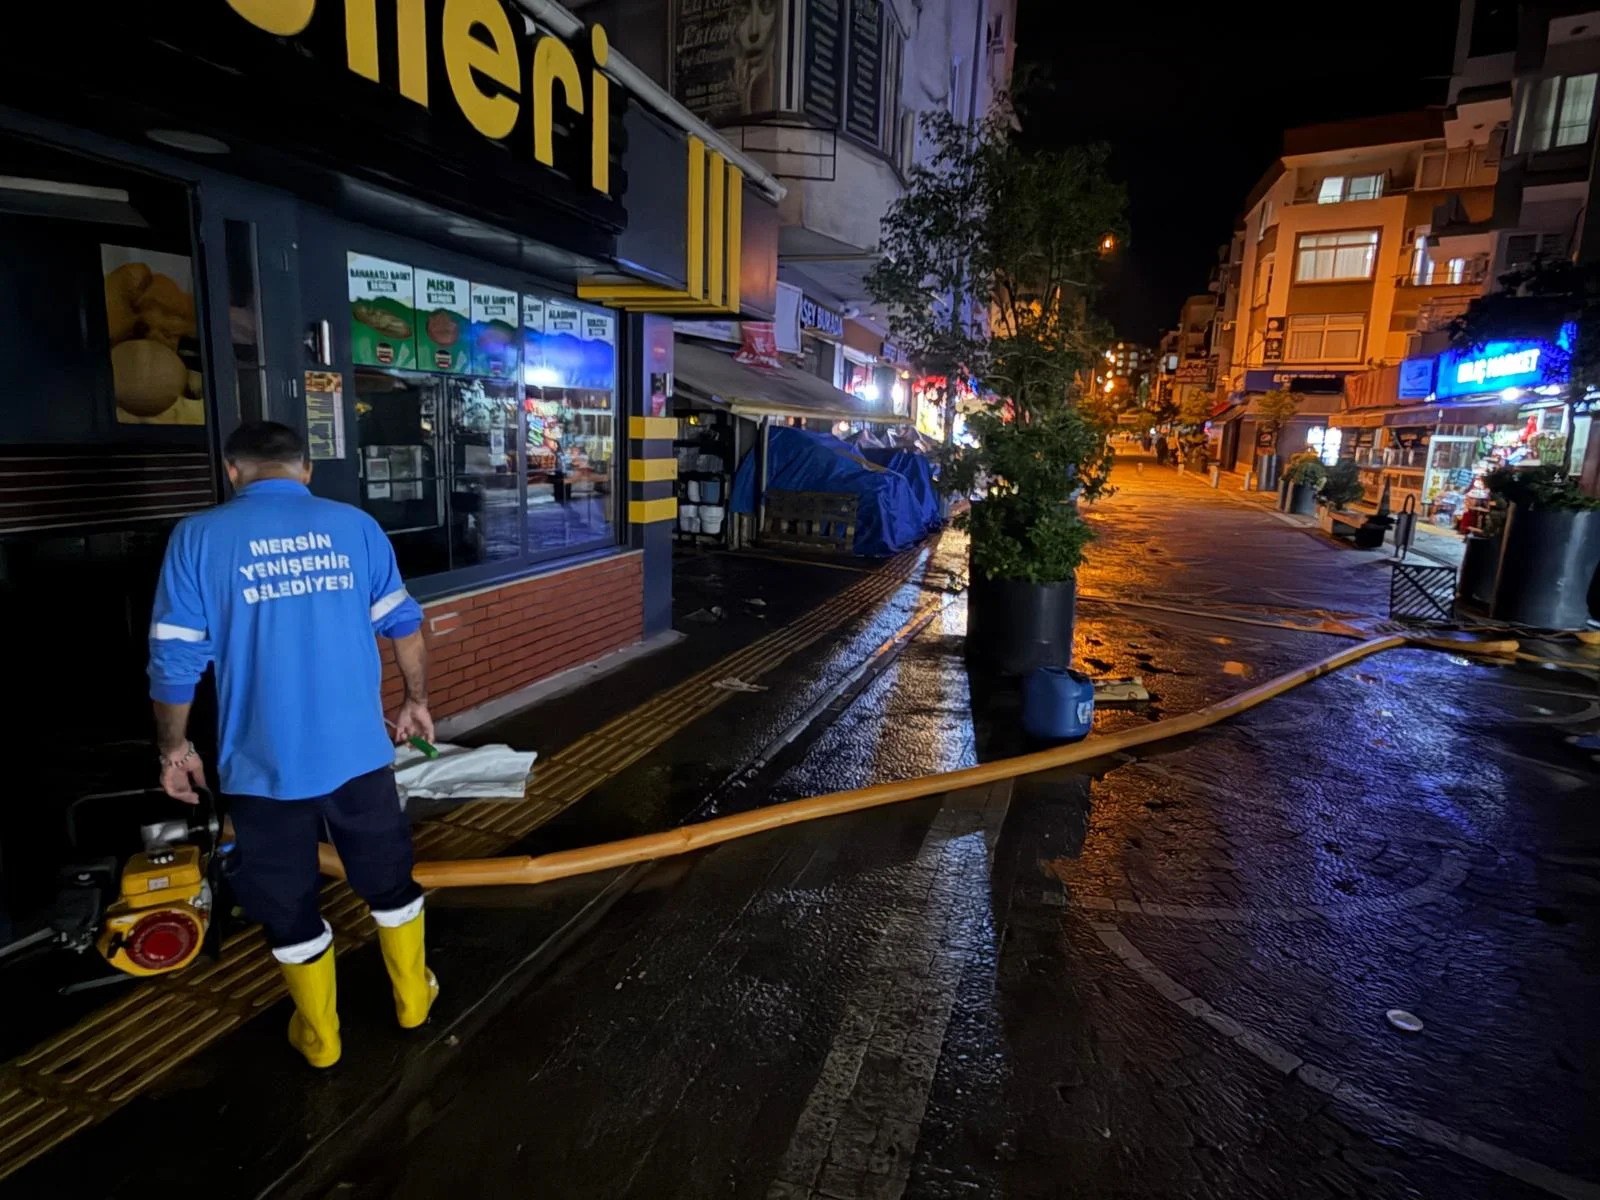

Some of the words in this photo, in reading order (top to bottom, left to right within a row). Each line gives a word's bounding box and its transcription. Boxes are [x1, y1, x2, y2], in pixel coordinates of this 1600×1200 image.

[426, 278, 456, 293] MISIR
[249, 531, 332, 557] MERSİN
[239, 551, 351, 581] YENİŞEHİR
[243, 572, 354, 605] BELEDİYESİ
